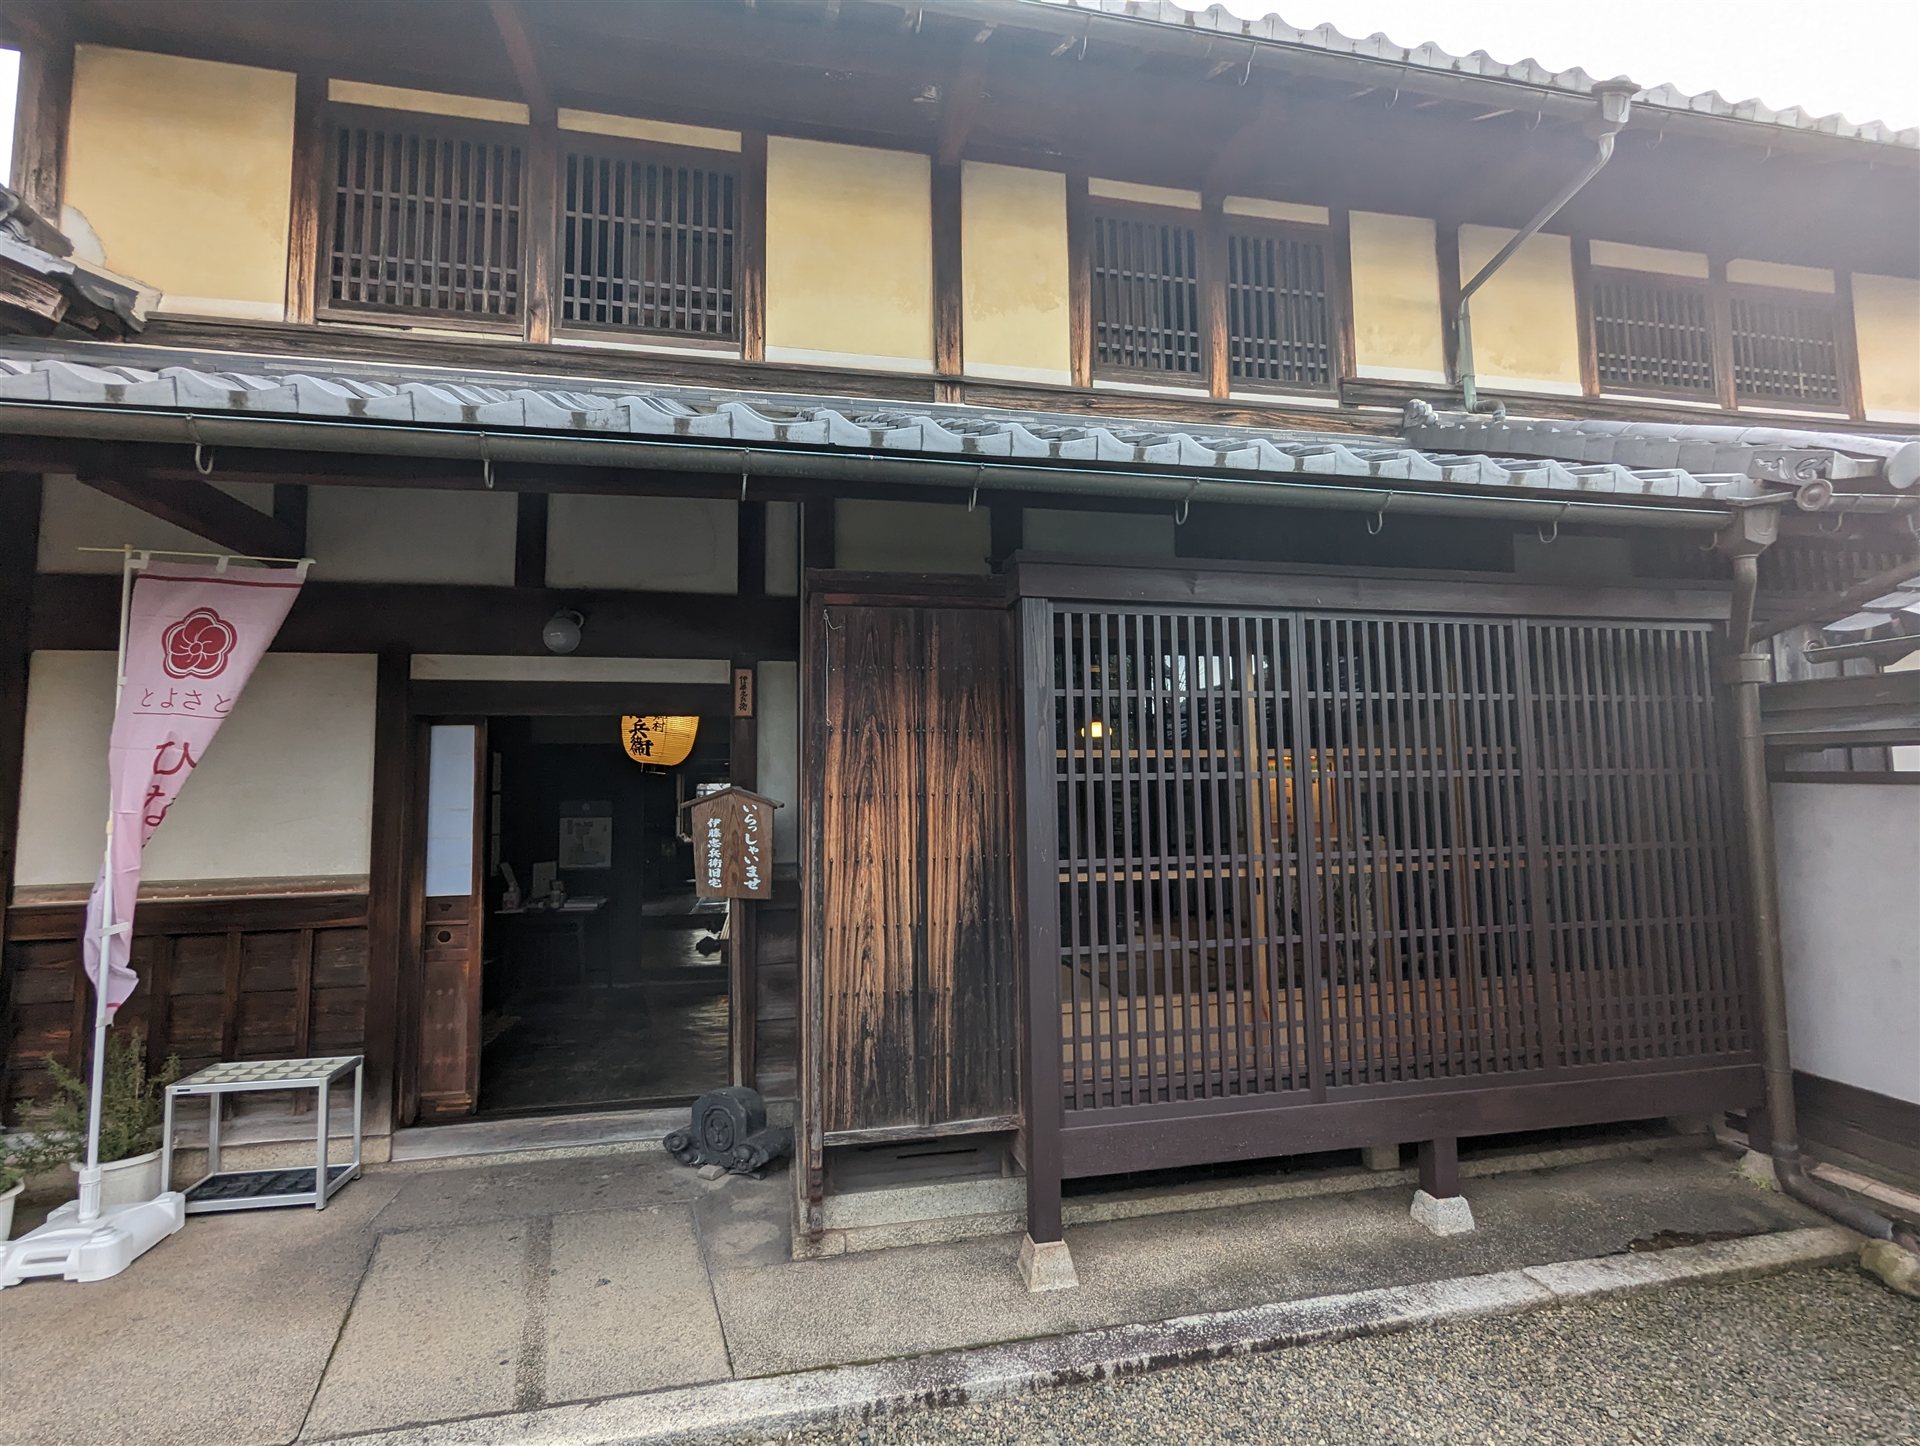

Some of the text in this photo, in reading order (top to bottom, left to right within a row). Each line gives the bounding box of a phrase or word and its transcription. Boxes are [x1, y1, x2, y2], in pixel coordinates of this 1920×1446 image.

[141, 687, 231, 713] とよさと
[628, 715, 654, 757] 兵衛
[141, 741, 197, 849] ひな
[707, 817, 723, 888] 伊藤忠兵衛旧宅
[742, 804, 761, 890] いらっしゃいませ
